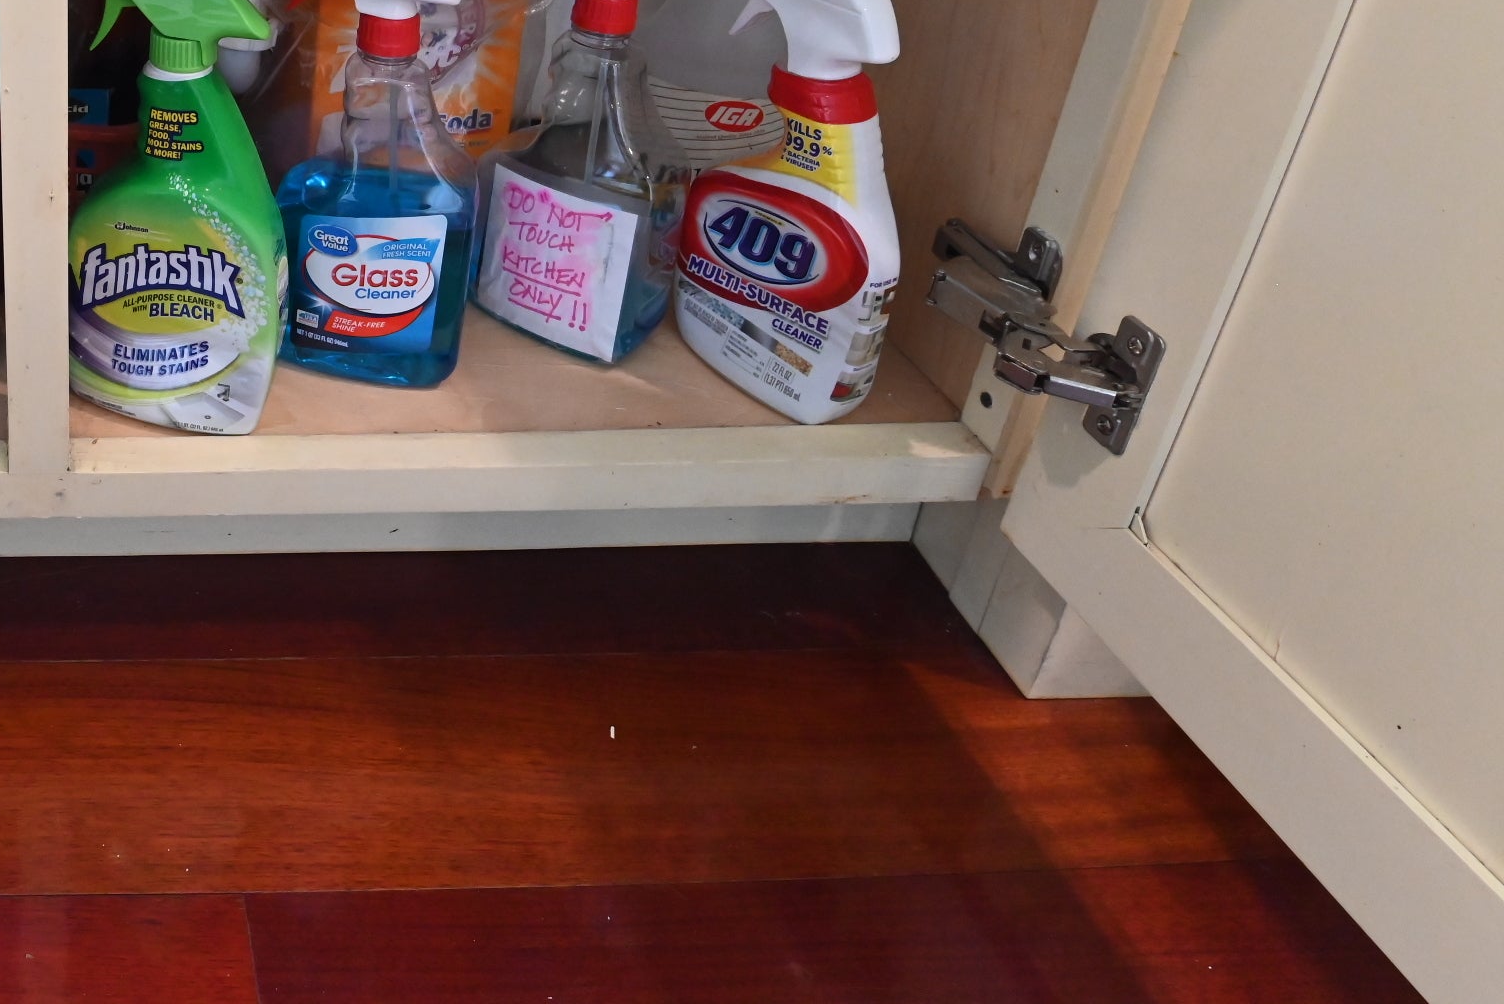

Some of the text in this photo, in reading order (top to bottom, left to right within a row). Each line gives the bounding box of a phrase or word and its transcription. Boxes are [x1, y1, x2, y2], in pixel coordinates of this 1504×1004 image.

[150, 108, 198, 123] REMOVES
[709, 105, 761, 127] IGA
[148, 129, 171, 141] FOOD,
[149, 120, 182, 133] GREASE,
[787, 117, 822, 141] KILLS
[145, 146, 182, 159] & MORE!
[147, 137, 203, 152] MOLD STAINS
[787, 150, 821, 167] BACTERIA
[507, 184, 535, 214] DO
[313, 229, 349, 246] Great
[508, 221, 575, 253] TOUCH
[707, 206, 816, 280] 409
[321, 239, 349, 253] Value
[381, 249, 432, 259] FRESH SCENT
[383, 242, 428, 252] ORIGINAL
[502, 244, 586, 288] KITCHEN
[81, 244, 240, 311] fantastik
[330, 262, 420, 288] Glass
[122, 293, 215, 310] ALL-PURPOSE CLEANER
[354, 287, 417, 300] Cleaner
[686, 253, 830, 336] MULTI-SURFACE
[132, 302, 215, 322] WITH BLEACH
[331, 322, 357, 333] SHINE
[334, 316, 386, 329] STREAK-FREE
[771, 317, 823, 350] CLEANER
[113, 340, 210, 362] ELIMINATES
[111, 354, 210, 376] TOUGH STAINS
